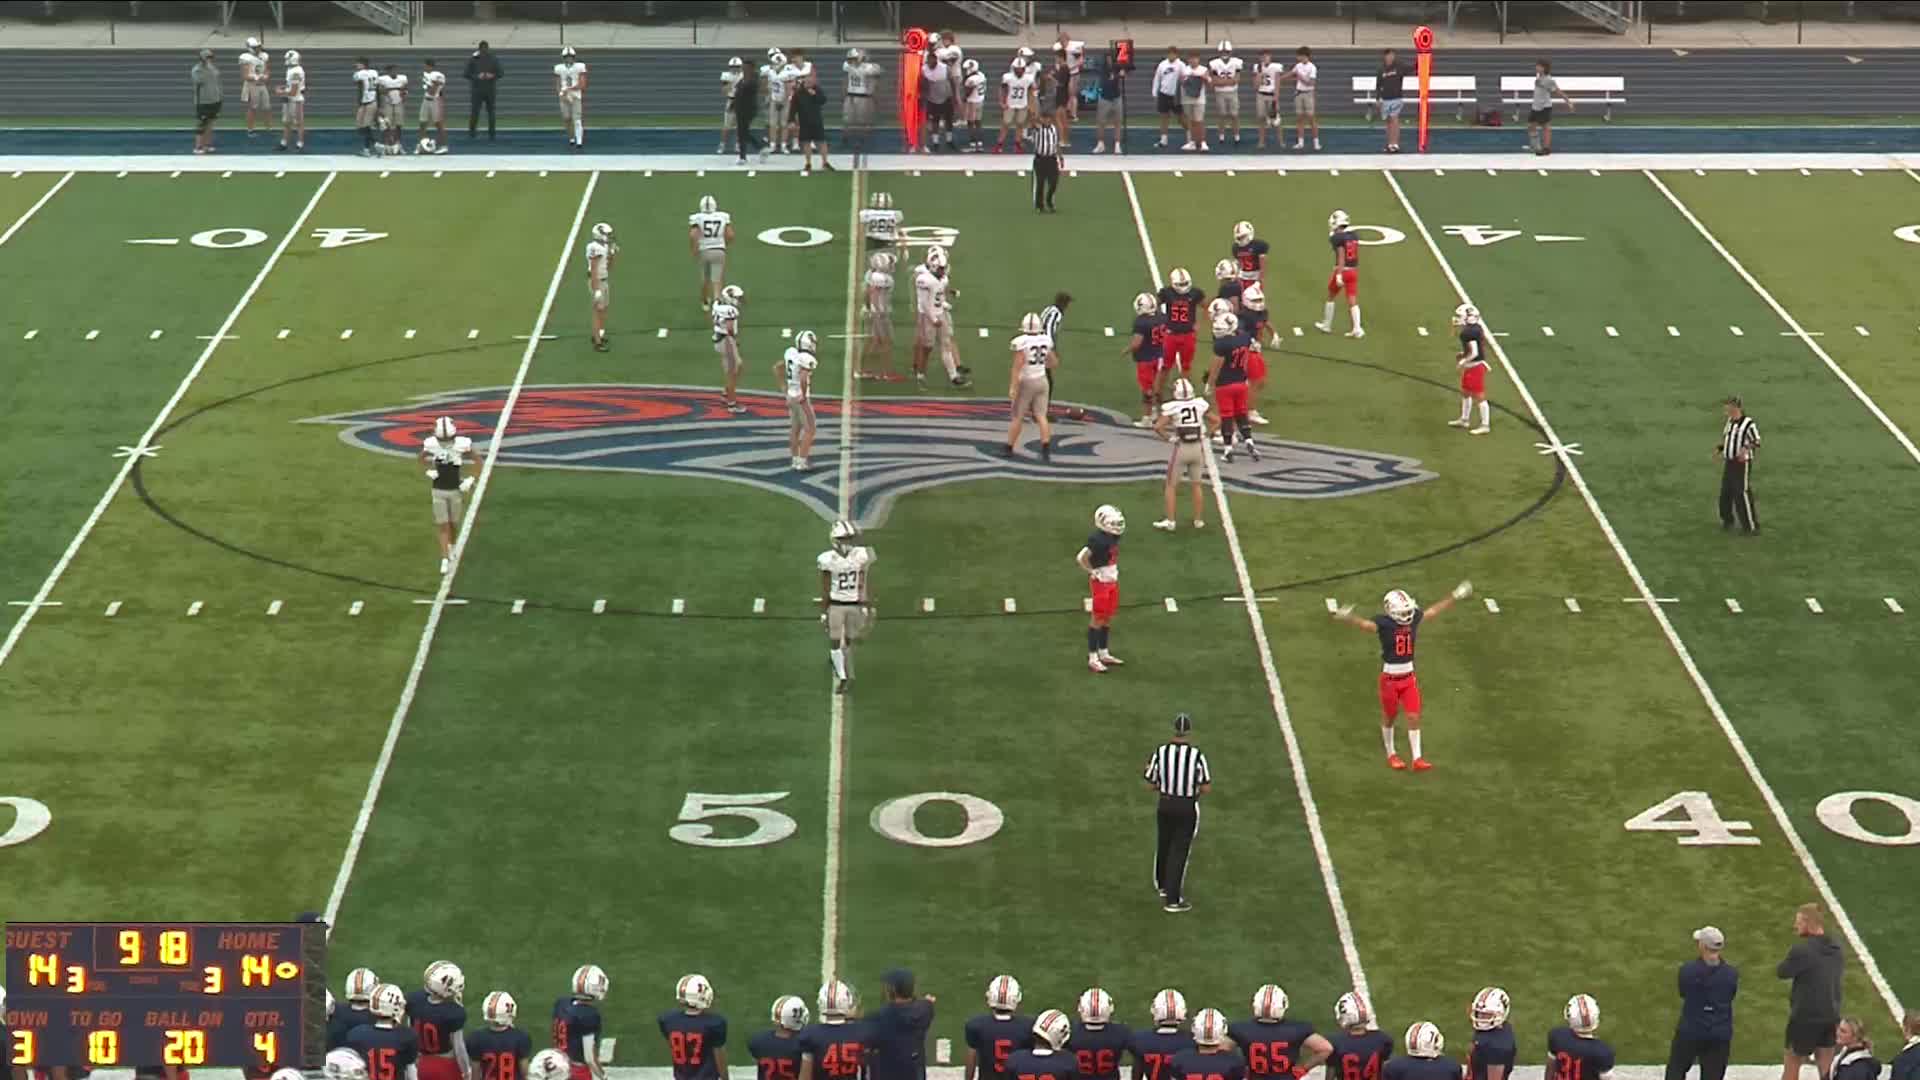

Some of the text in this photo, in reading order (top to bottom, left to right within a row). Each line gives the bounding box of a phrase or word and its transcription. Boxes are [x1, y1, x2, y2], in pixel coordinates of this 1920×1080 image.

[703, 220, 721, 238] 57
[1180, 406, 1198, 424] 21
[1396, 634, 1412, 656] 81
[822, 1042, 864, 1075] 45
[1249, 1041, 1289, 1074] 65
[1341, 1052, 1381, 1080] 64
